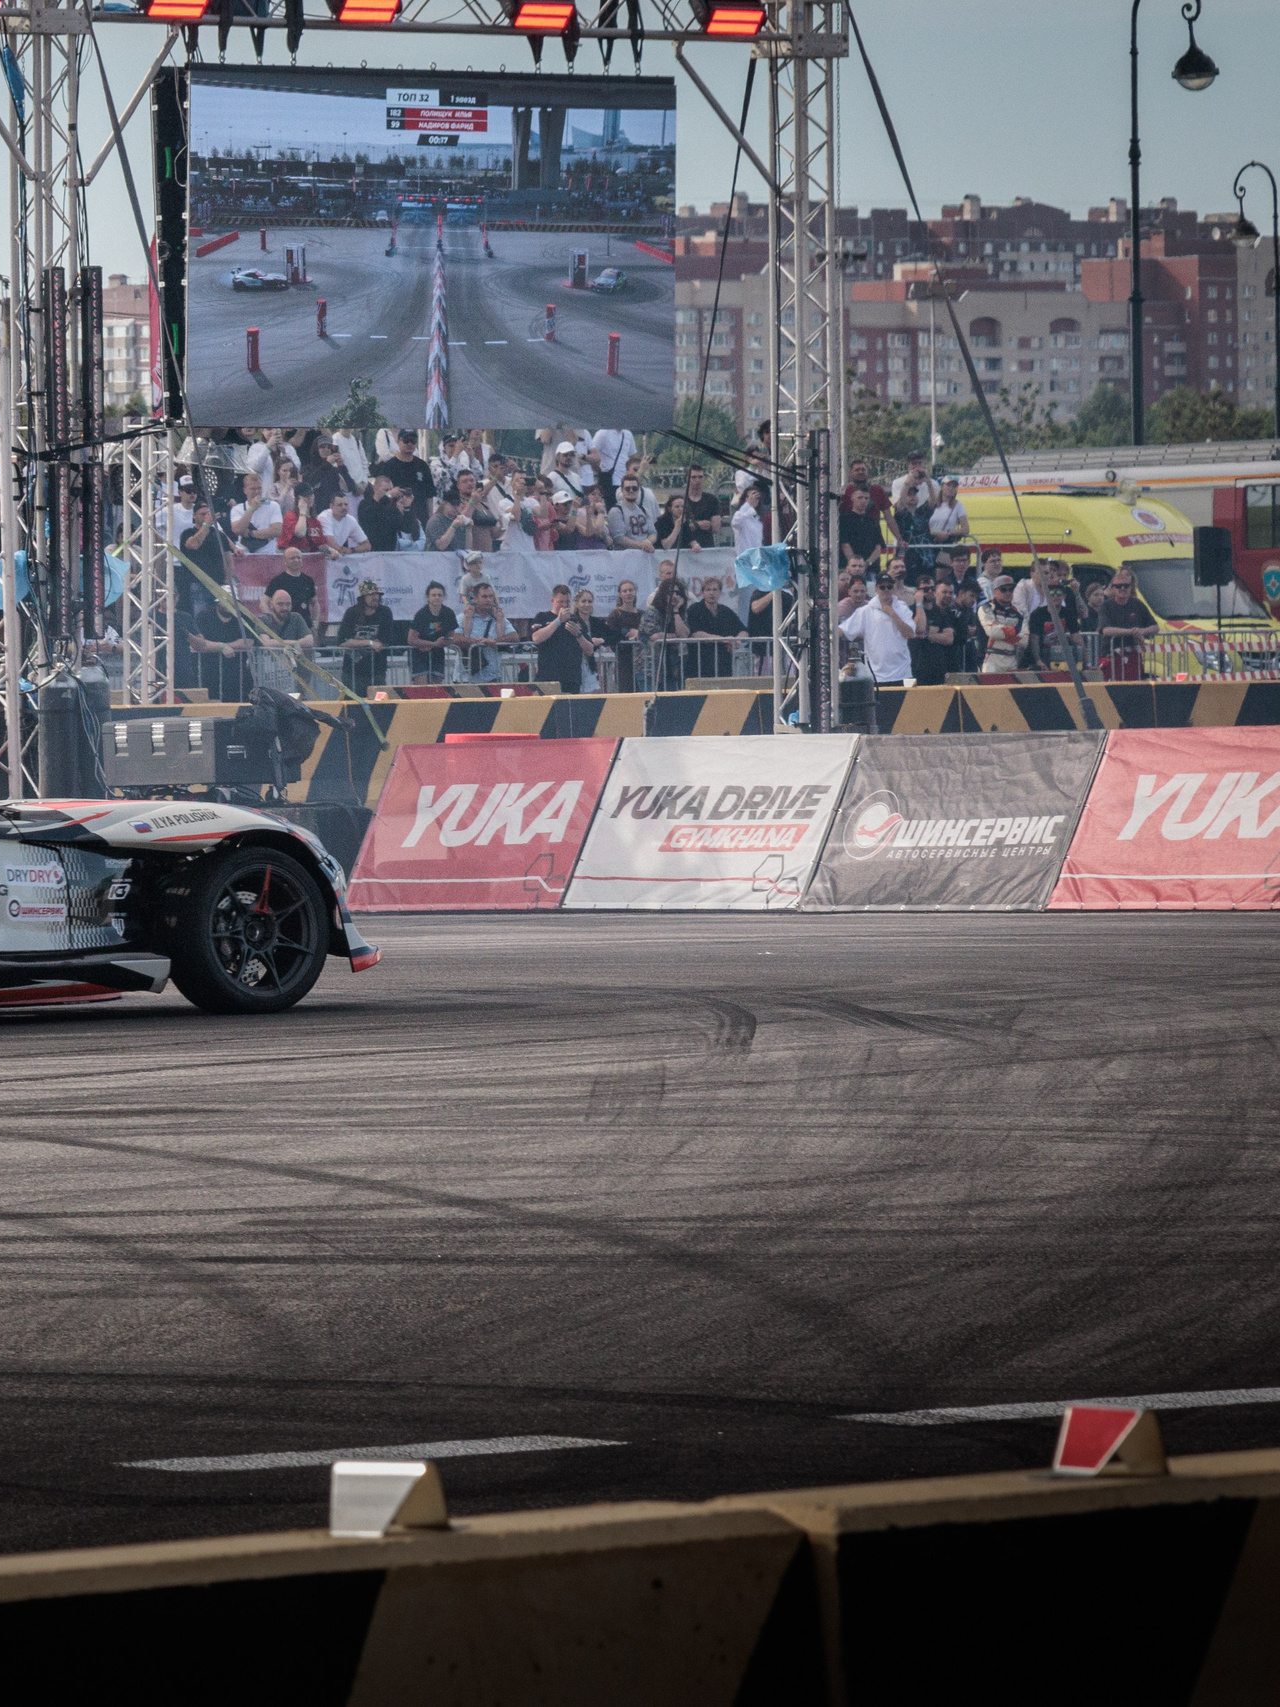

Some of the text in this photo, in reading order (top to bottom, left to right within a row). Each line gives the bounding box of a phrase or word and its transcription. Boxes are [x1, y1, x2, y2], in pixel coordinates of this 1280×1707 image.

[397, 93, 430, 102] ТОП 32
[420, 110, 452, 118] ПОЛИЩУК
[418, 121, 474, 130] НАДИРОВ ФАРИД
[428, 136, 449, 144] 00:17
[610, 785, 832, 820] YUKA DRIVE
[151, 810, 221, 829] ILYA POLISHUK
[400, 780, 584, 848] YUKA
[670, 826, 797, 849] GYMKHANA
[892, 815, 1065, 847] ШИНСЕРВИС
[886, 845, 1053, 859] АВТОСЕРВИСНЫЕ ЦЕНТРЫ
[6, 868, 53, 883] DRYDRY
[21, 906, 64, 915] ШИНСЕРВИС
